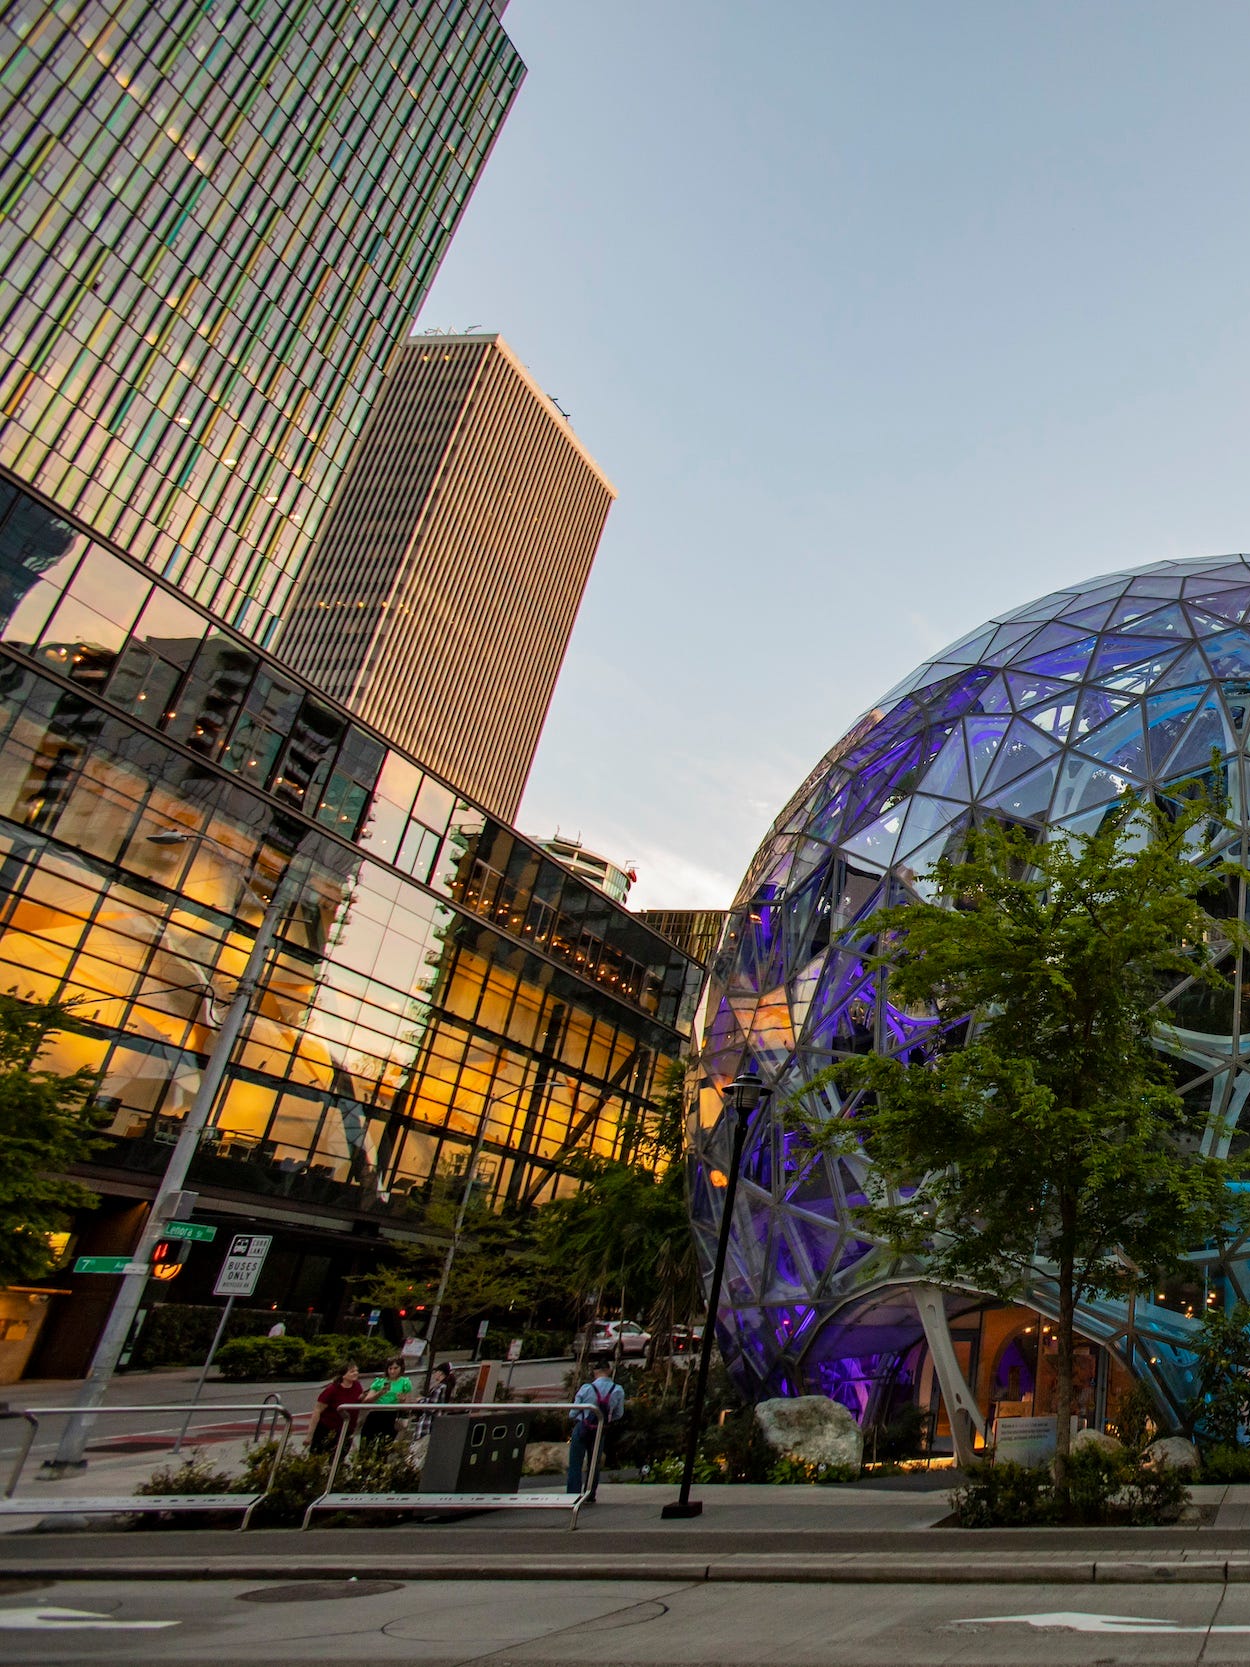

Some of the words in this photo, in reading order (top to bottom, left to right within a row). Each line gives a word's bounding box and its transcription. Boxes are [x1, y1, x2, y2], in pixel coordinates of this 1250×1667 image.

[166, 1224, 193, 1237] Lenora
[228, 1262, 257, 1271] BUSES
[228, 1271, 251, 1280] ONLY
